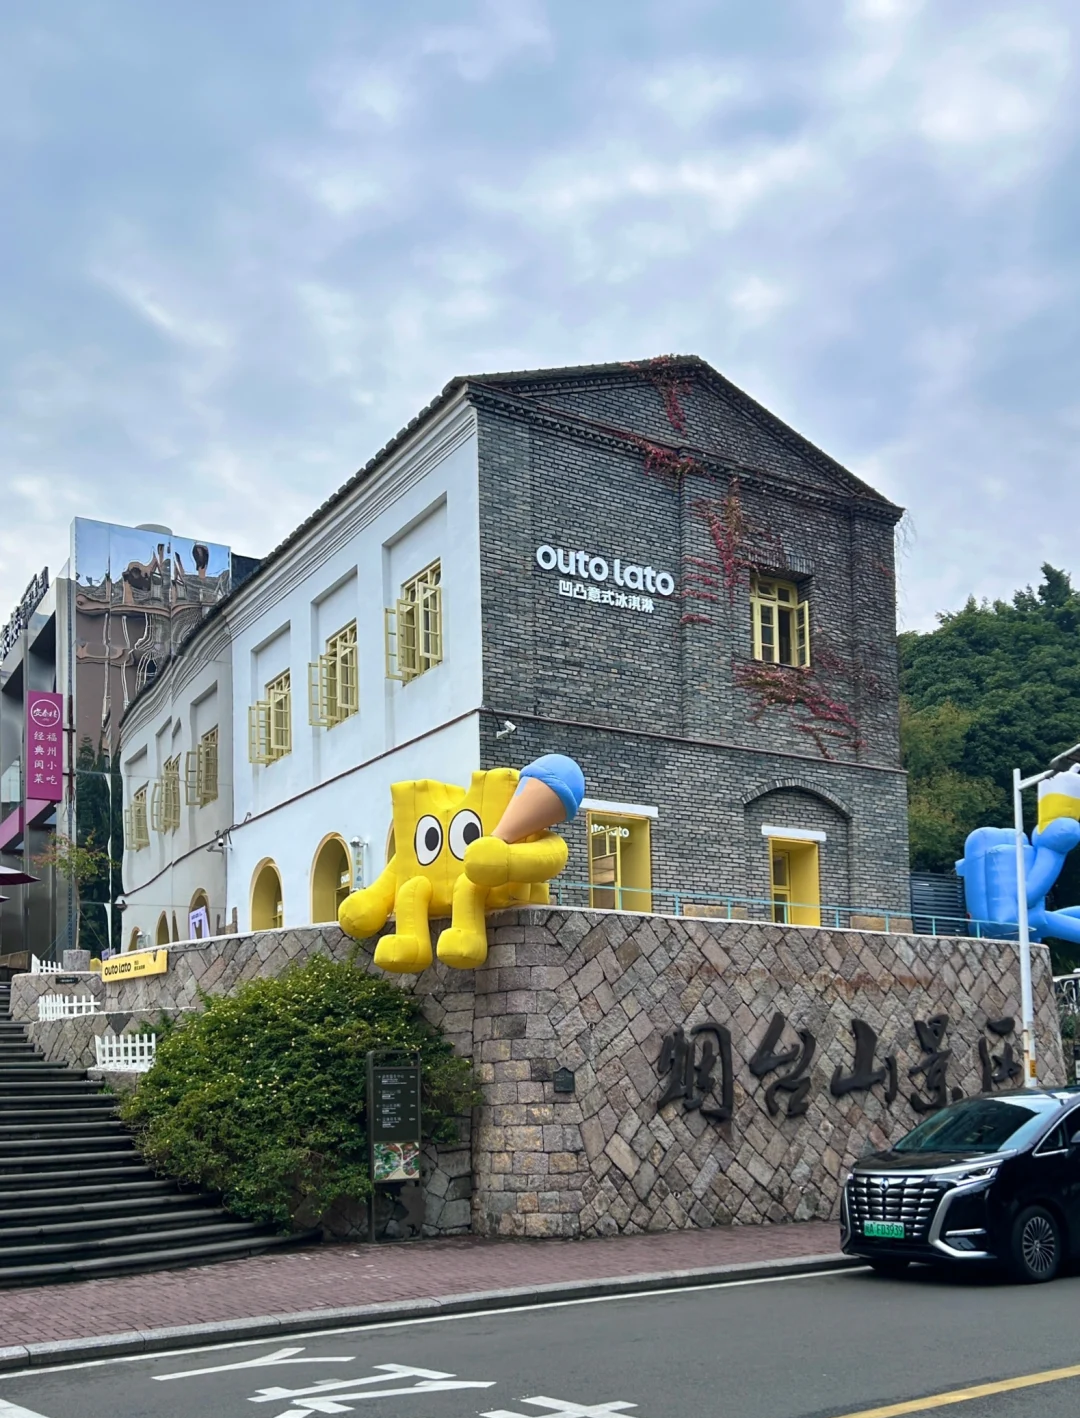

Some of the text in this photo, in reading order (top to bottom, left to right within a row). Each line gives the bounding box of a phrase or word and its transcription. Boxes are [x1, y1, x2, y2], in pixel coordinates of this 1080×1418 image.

[536, 545, 675, 596] outo lato
[558, 580, 655, 614] 凹凸意式冰淇淋
[33, 731, 45, 784] 经典闽菜
[46, 732, 58, 785] 福州小吃
[104, 965, 118, 976] outo
[119, 962, 132, 974] lato
[657, 1011, 1022, 1121] 烟台山景区
